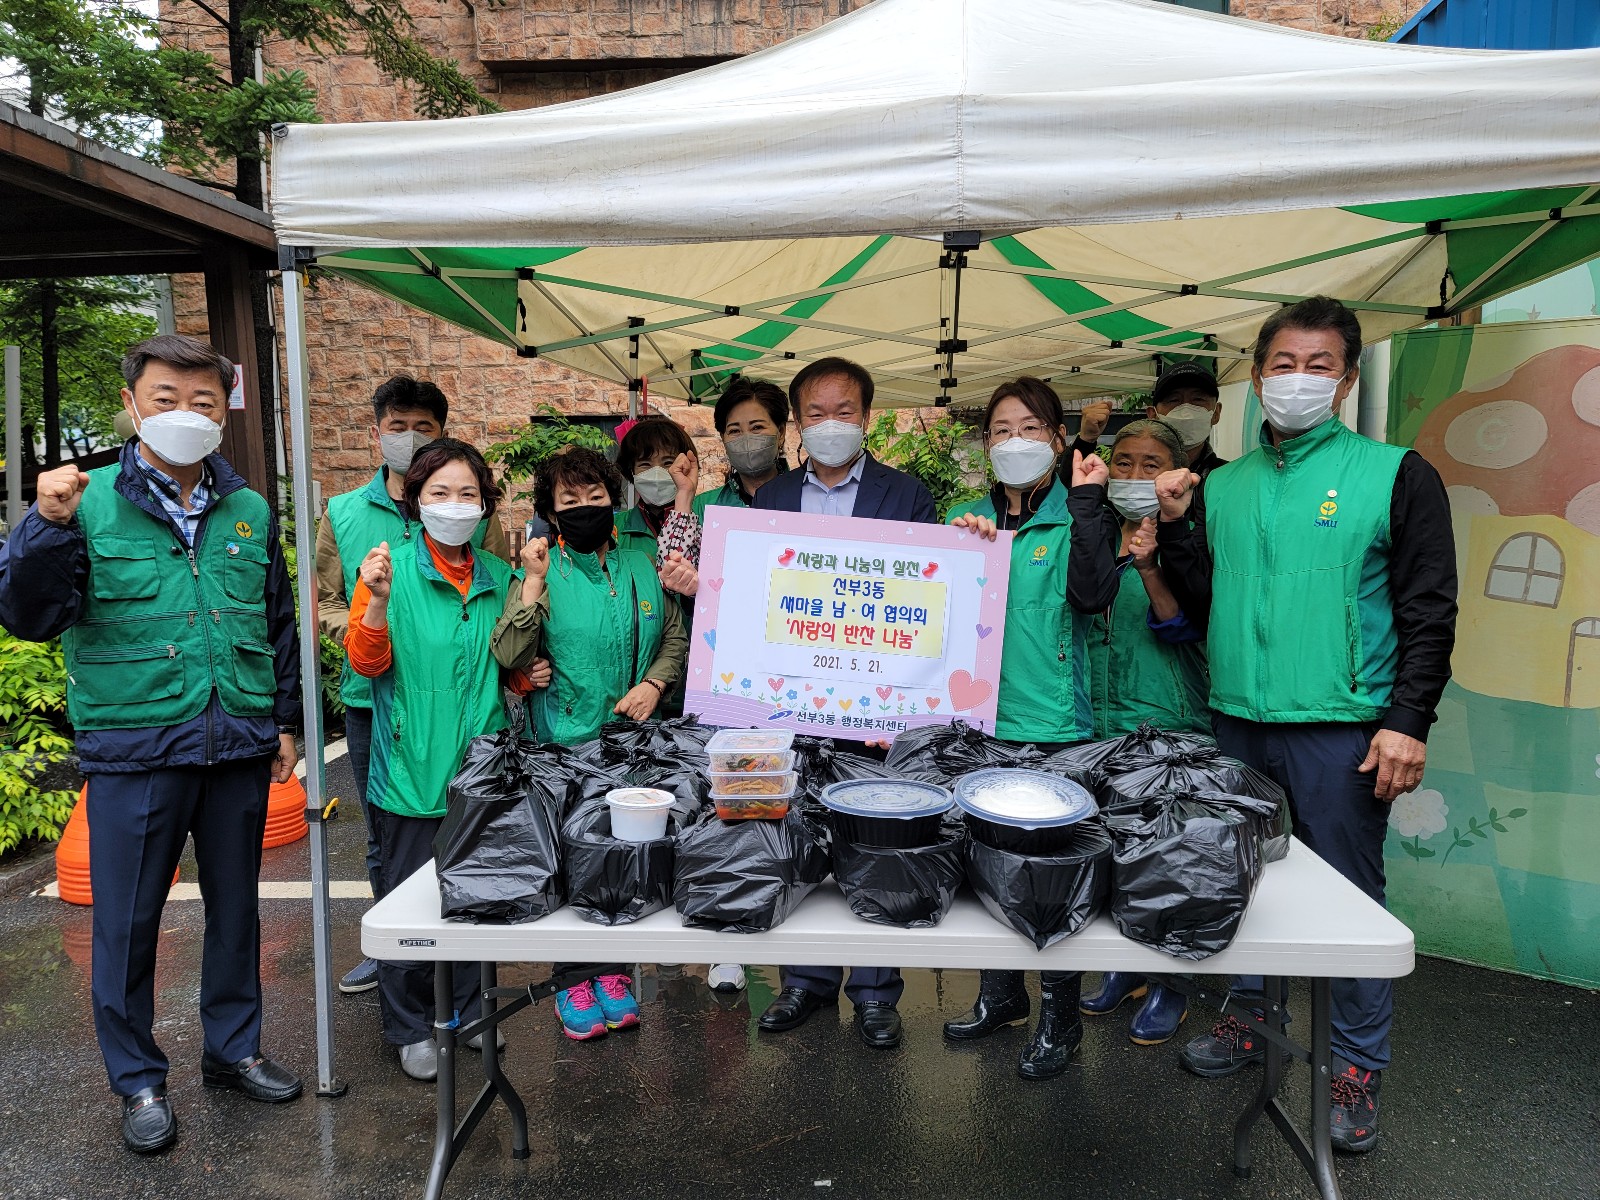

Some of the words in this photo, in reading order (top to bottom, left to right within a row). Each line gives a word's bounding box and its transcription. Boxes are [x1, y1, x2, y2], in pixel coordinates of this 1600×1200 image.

[1314, 519, 1338, 528] SMU
[796, 551, 838, 571] 사랑과
[844, 555, 886, 575] 나눔의
[892, 559, 920, 578] 실천
[1029, 559, 1050, 567] SMU
[833, 577, 885, 600] 선부3동
[780, 595, 824, 617] 새마을
[884, 604, 928, 626] 협의회
[844, 624, 875, 646] 반찬
[813, 654, 843, 670] 2021.
[850, 658, 860, 672] 5.
[868, 660, 883, 674] 21.
[796, 711, 836, 726] 선부3동
[841, 715, 908, 732] 행정복지센터
[401, 939, 434, 947] LIFETIME
